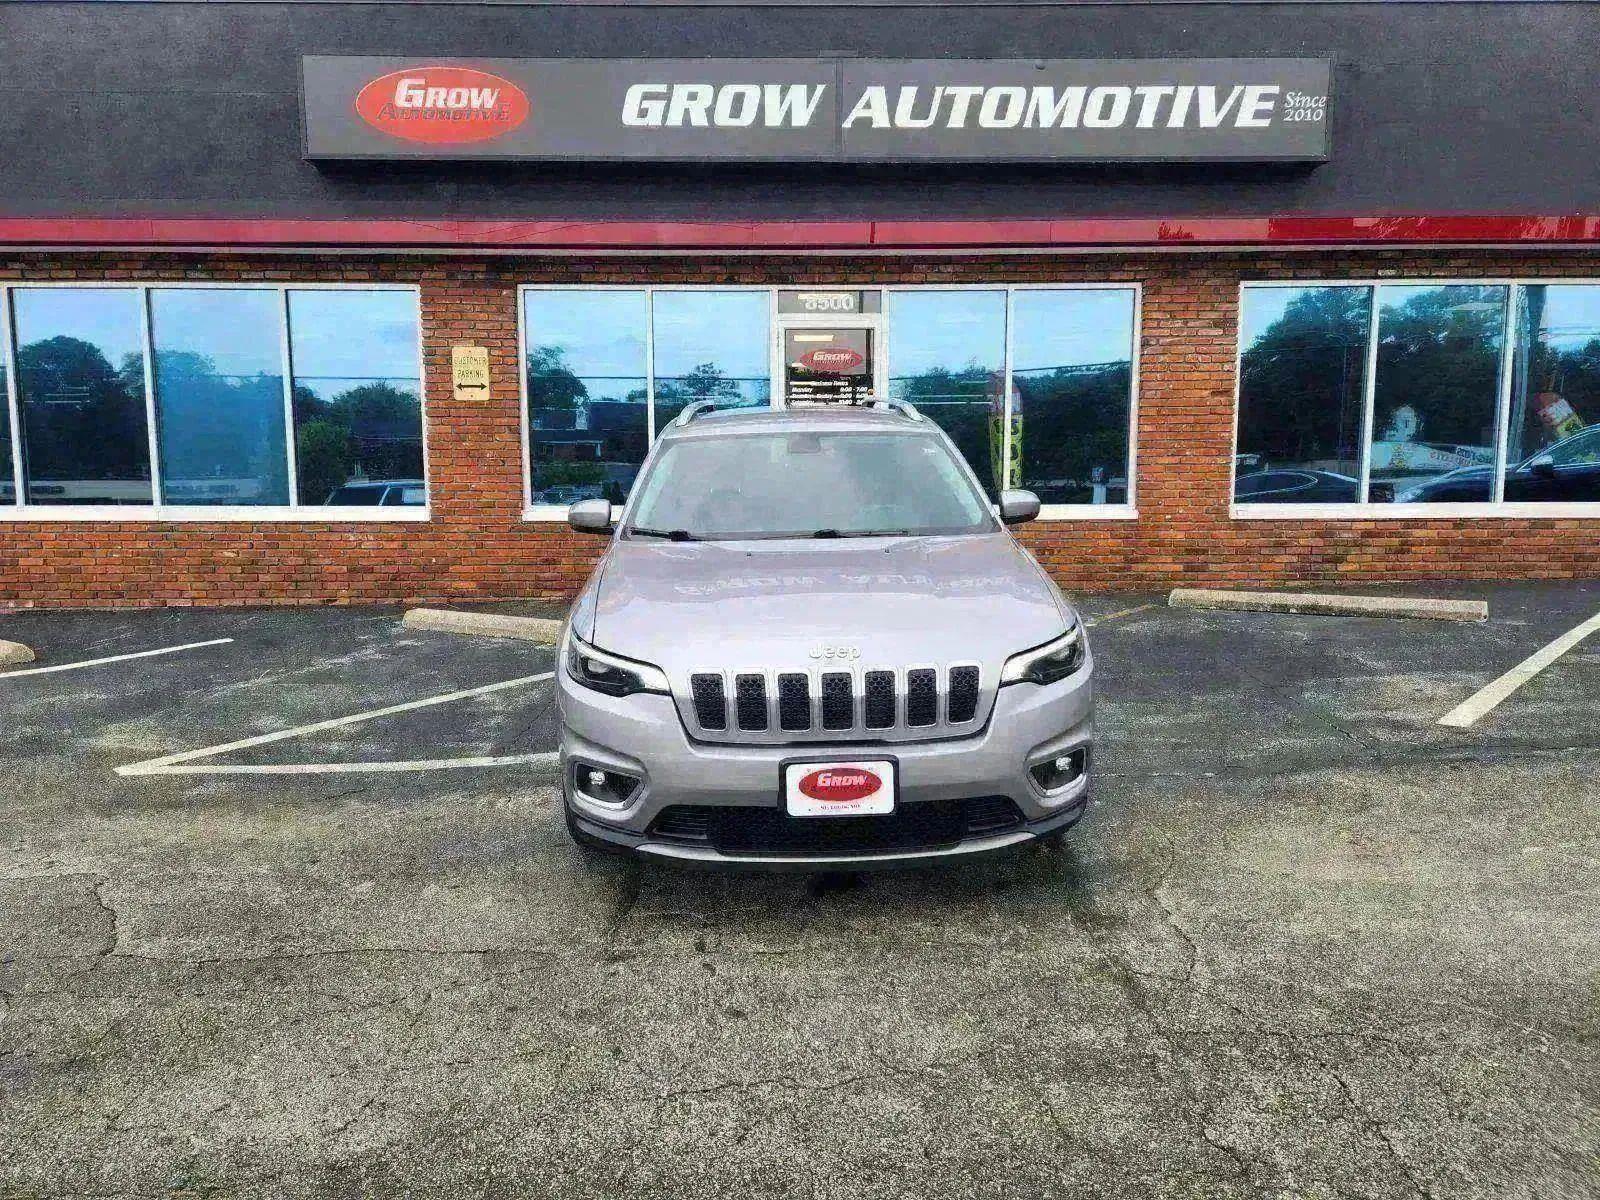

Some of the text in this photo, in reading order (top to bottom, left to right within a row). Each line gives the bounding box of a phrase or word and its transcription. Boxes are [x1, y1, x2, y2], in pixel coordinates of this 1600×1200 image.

[394, 78, 499, 109] GROW
[1284, 91, 1327, 108] Since
[621, 83, 1280, 129] GROW AUTOMOTIVE
[1283, 109, 1323, 122] 2010
[457, 370, 484, 378] PARKING
[808, 642, 861, 662] Jeep
[817, 773, 867, 787] GROW
